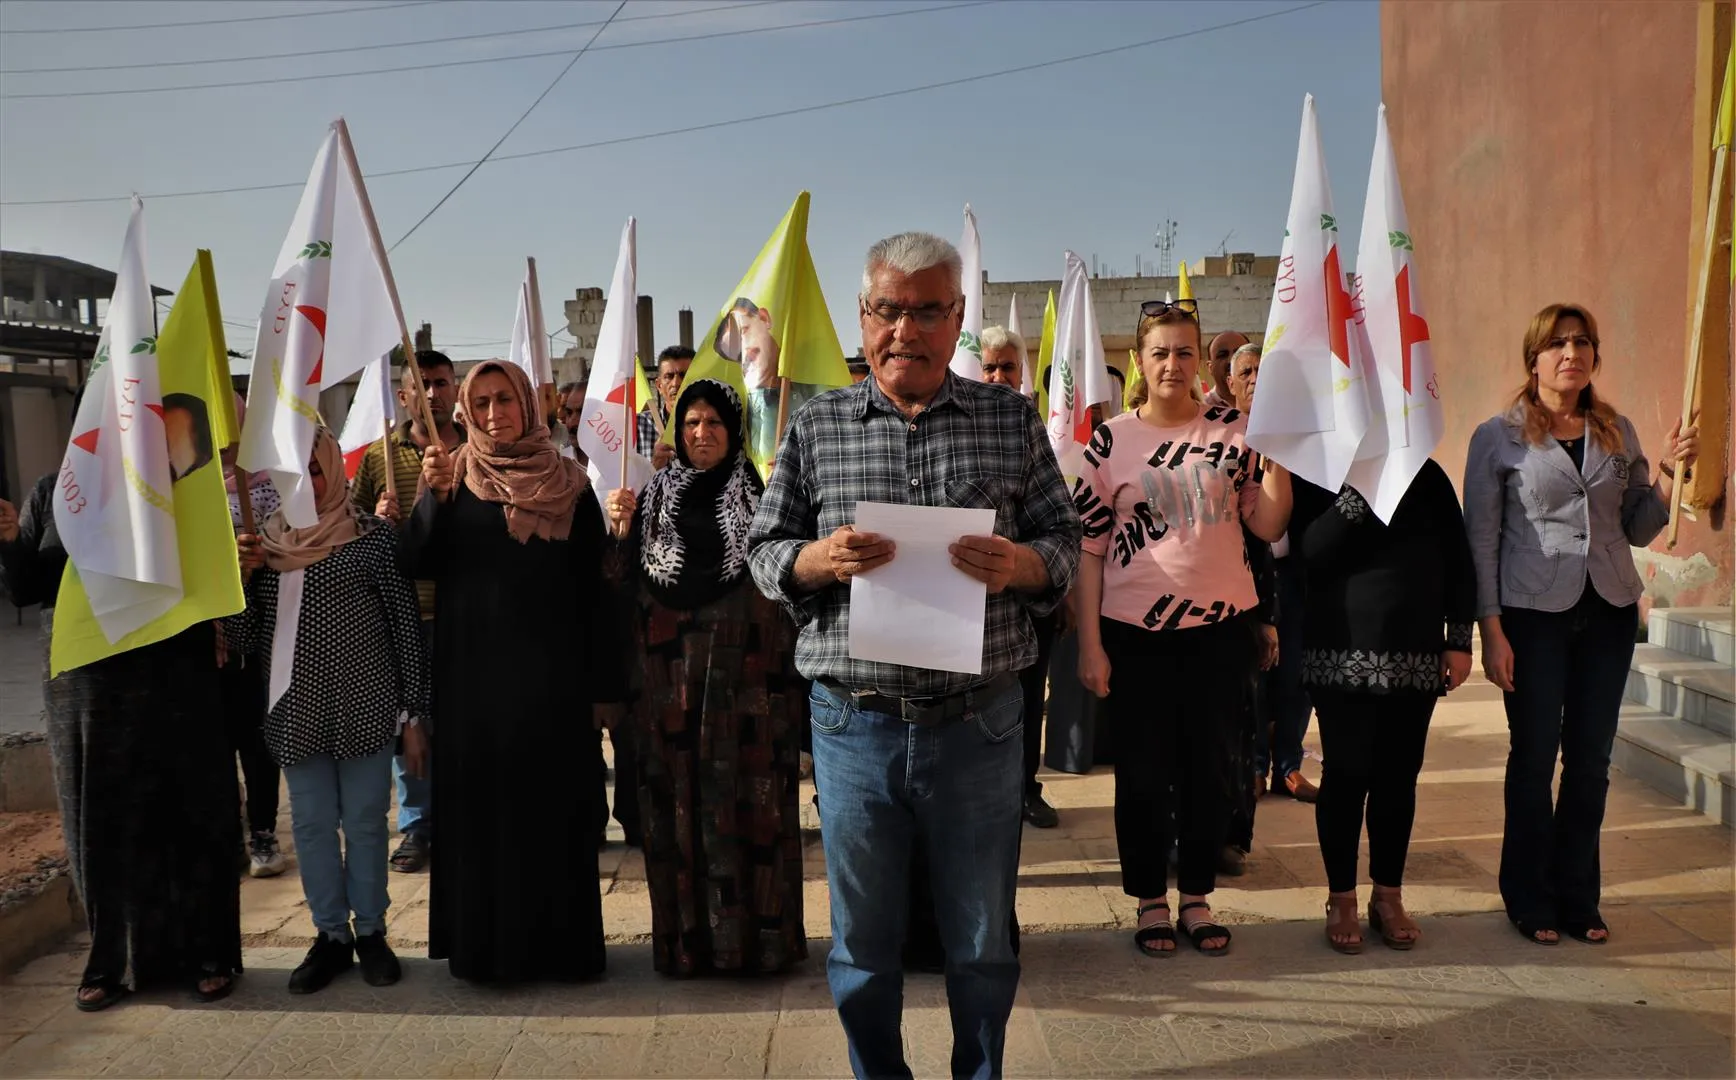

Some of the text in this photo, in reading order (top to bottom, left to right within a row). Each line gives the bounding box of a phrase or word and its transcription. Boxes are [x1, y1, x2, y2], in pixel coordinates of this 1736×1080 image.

[1279, 255, 1297, 304] PYD
[274, 282, 296, 334] PYD
[119, 377, 141, 432] PYD
[587, 411, 623, 452] 2003
[61, 456, 88, 515] 2003
